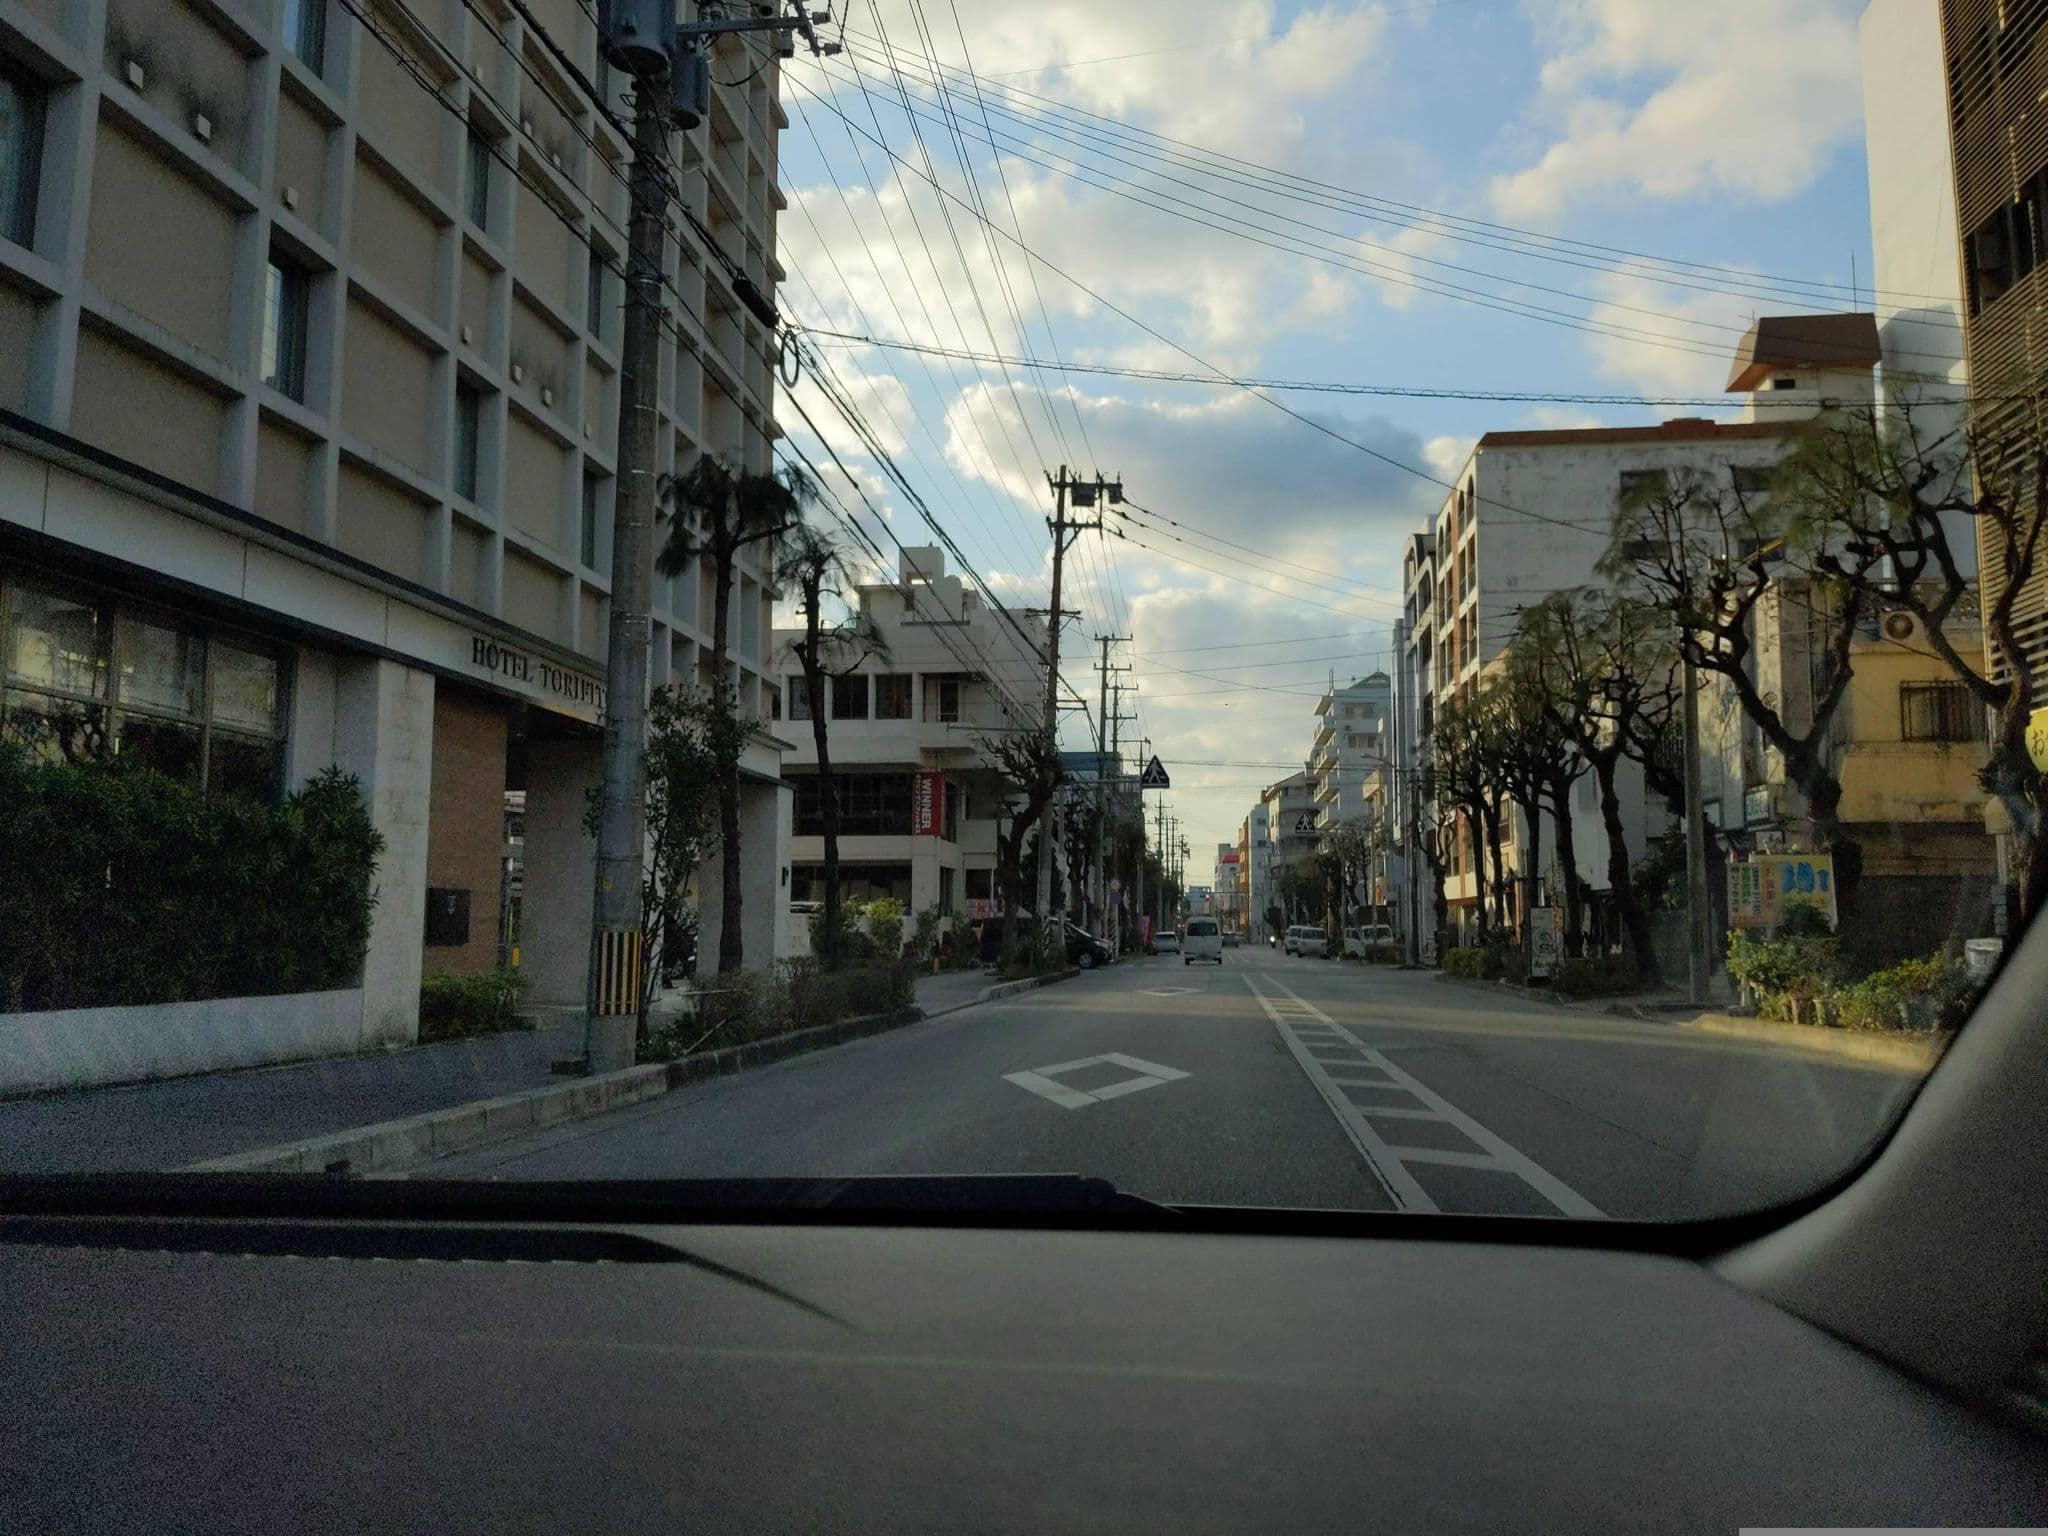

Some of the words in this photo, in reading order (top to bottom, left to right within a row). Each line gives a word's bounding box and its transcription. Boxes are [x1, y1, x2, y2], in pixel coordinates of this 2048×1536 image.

[472, 636, 534, 683] HOTEL
[541, 663, 606, 708] TORIFIT
[922, 779, 932, 829] WINNER
